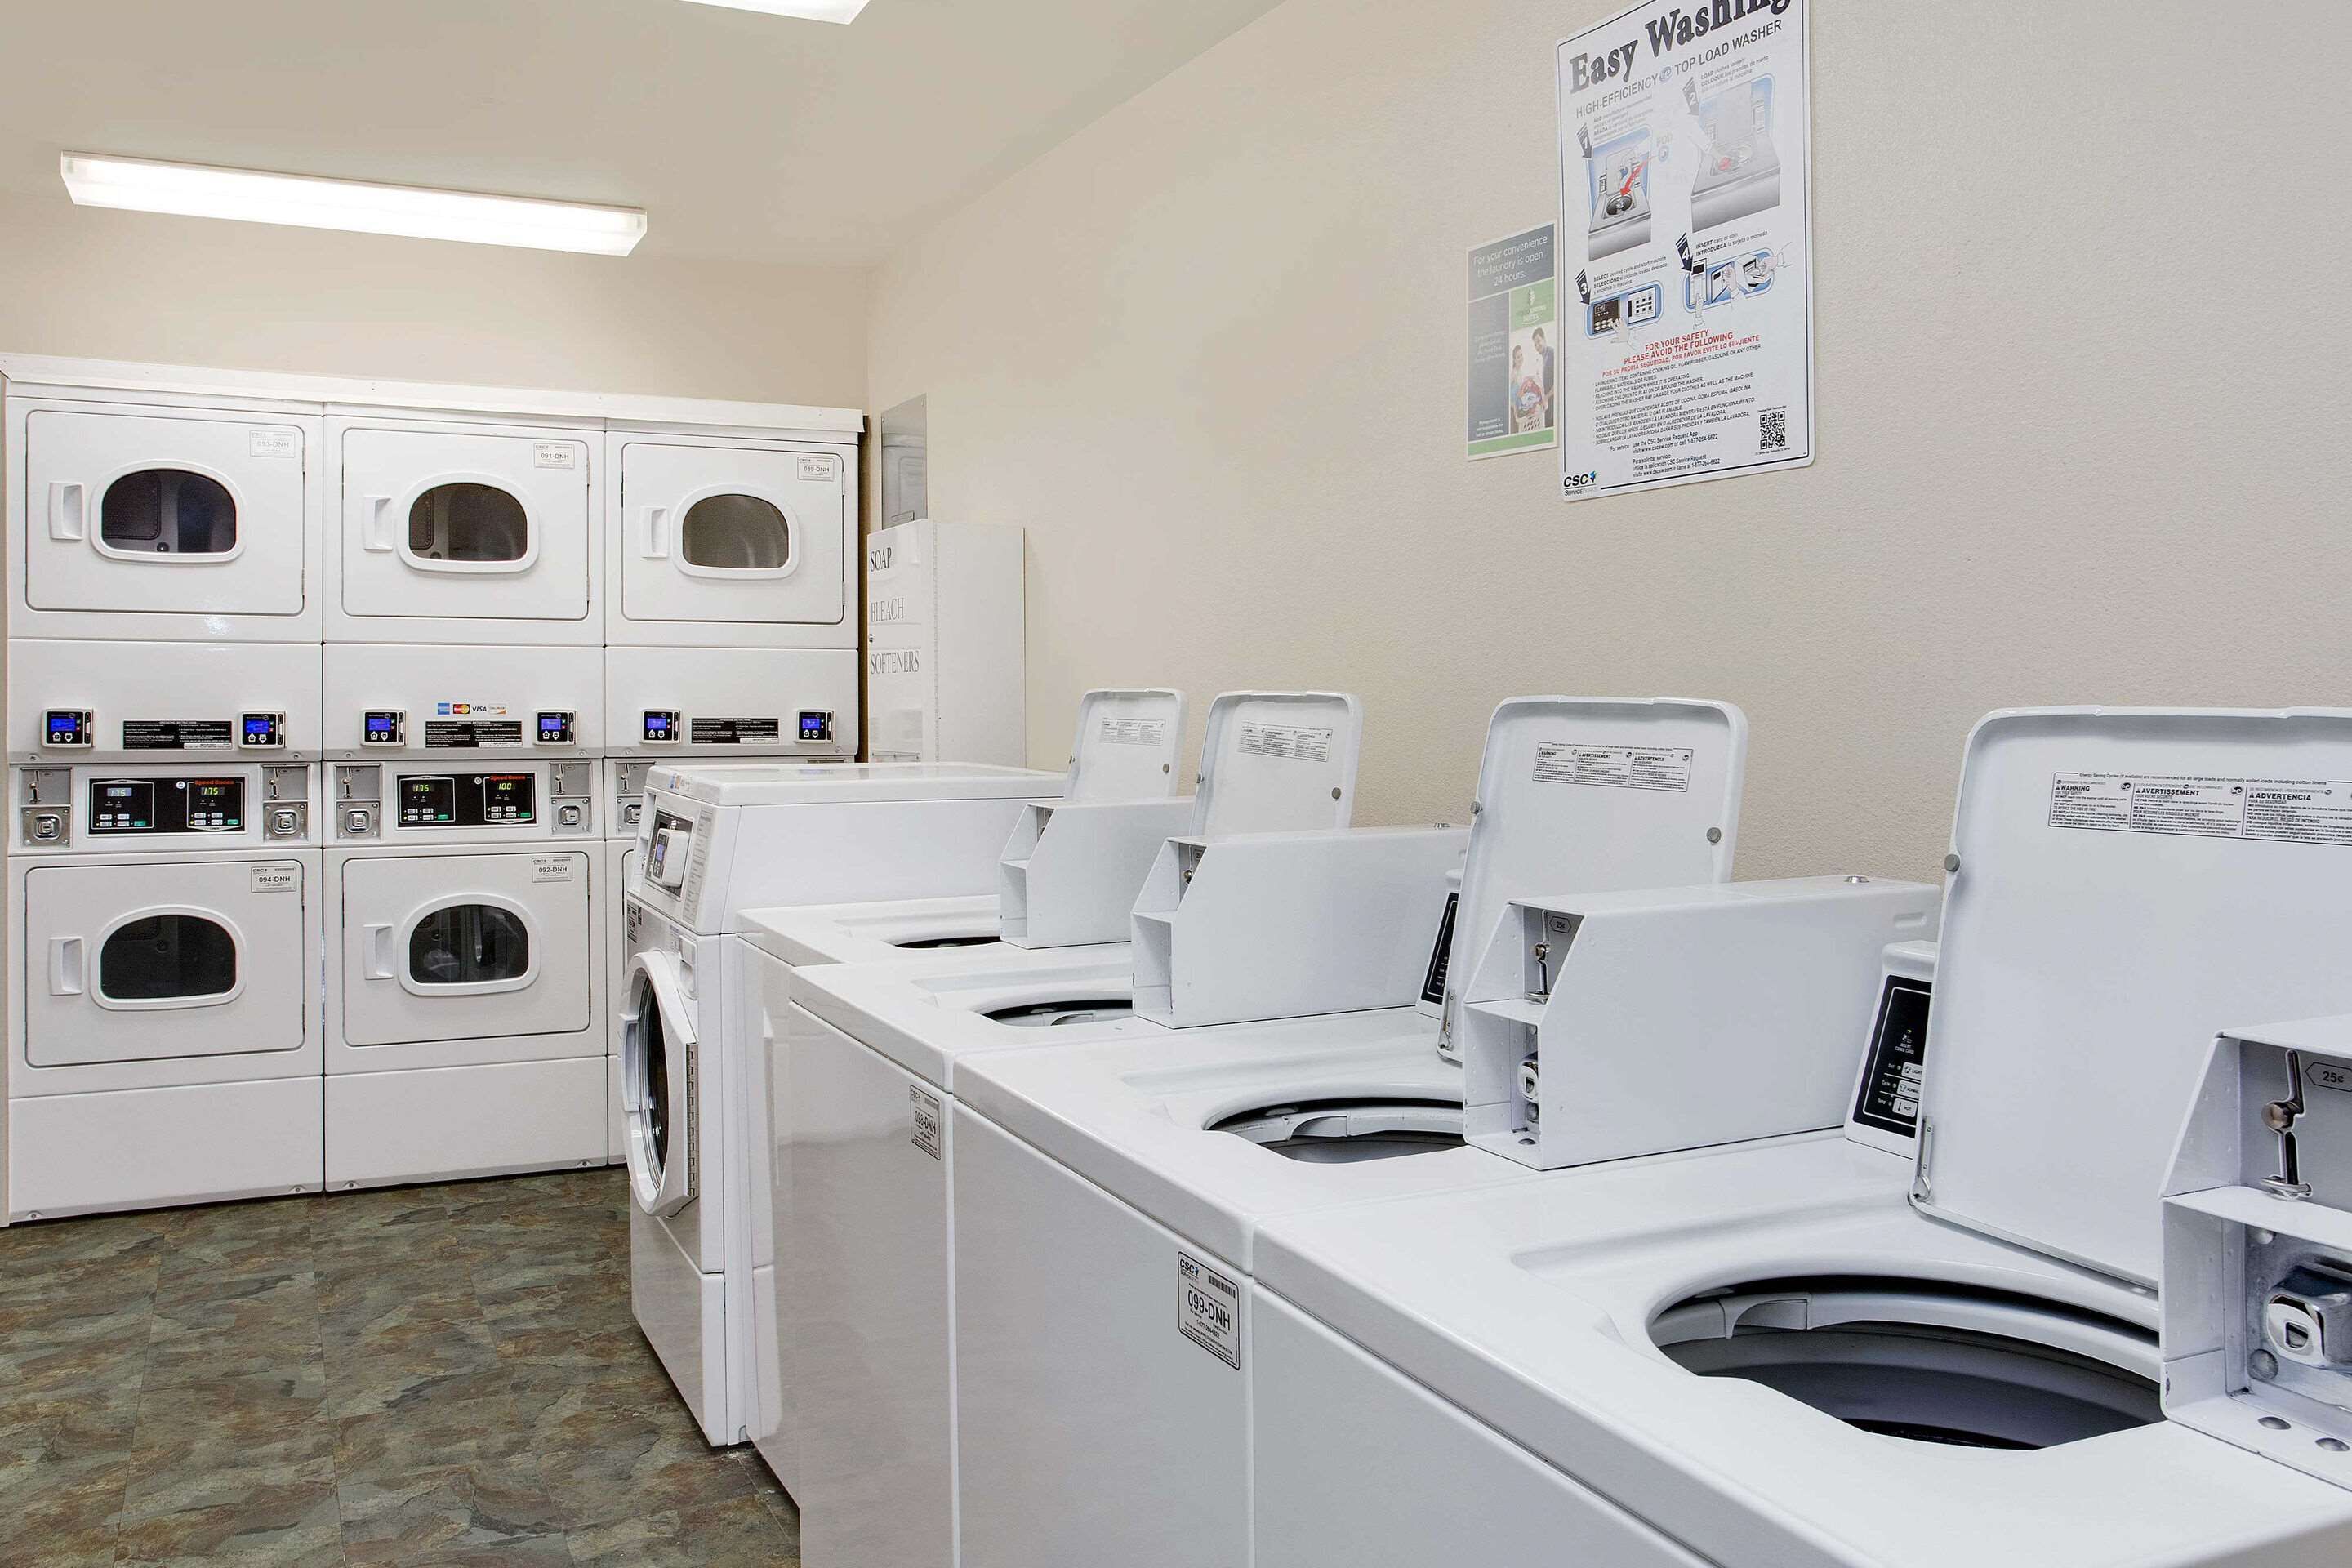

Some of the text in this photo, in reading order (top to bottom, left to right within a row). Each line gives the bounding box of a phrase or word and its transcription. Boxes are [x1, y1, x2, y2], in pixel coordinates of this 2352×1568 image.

[1570, 39, 1638, 94] Easy
[1576, 73, 1658, 118] HIGH-EFFICIENCY
[1674, 57, 1696, 75] TOP
[1699, 42, 1729, 65] LOAD
[1732, 19, 1782, 50] WASHER
[1487, 250, 1502, 262] your
[1503, 236, 1548, 256] convenience
[1682, 247, 1690, 260] 4
[1696, 239, 1712, 249] INSERT
[1490, 260, 1516, 275] laundry
[1517, 256, 1523, 265] is
[1525, 251, 1544, 264] open
[1580, 283, 1588, 295] 3
[1624, 331, 1733, 364] PLEASE AVOID THE FOLLOWING
[1645, 329, 1708, 351] FOR YOUR SAFETY
[1621, 364, 1638, 373] PROPIA
[1684, 348, 1702, 358] FAVOR
[1703, 345, 1717, 353] EVITE
[1728, 335, 1759, 347] SIGUIENTE
[1672, 432, 1688, 440] Request
[1564, 474, 1588, 488] CSC
[870, 547, 892, 572] SOAP
[871, 597, 904, 622] BLEACH
[870, 650, 920, 675] SOFTENERS
[2323, 1071, 2344, 1083] 25¢
[1180, 1259, 1195, 1274] CSC
[1188, 1290, 1231, 1331] 099-DNH
